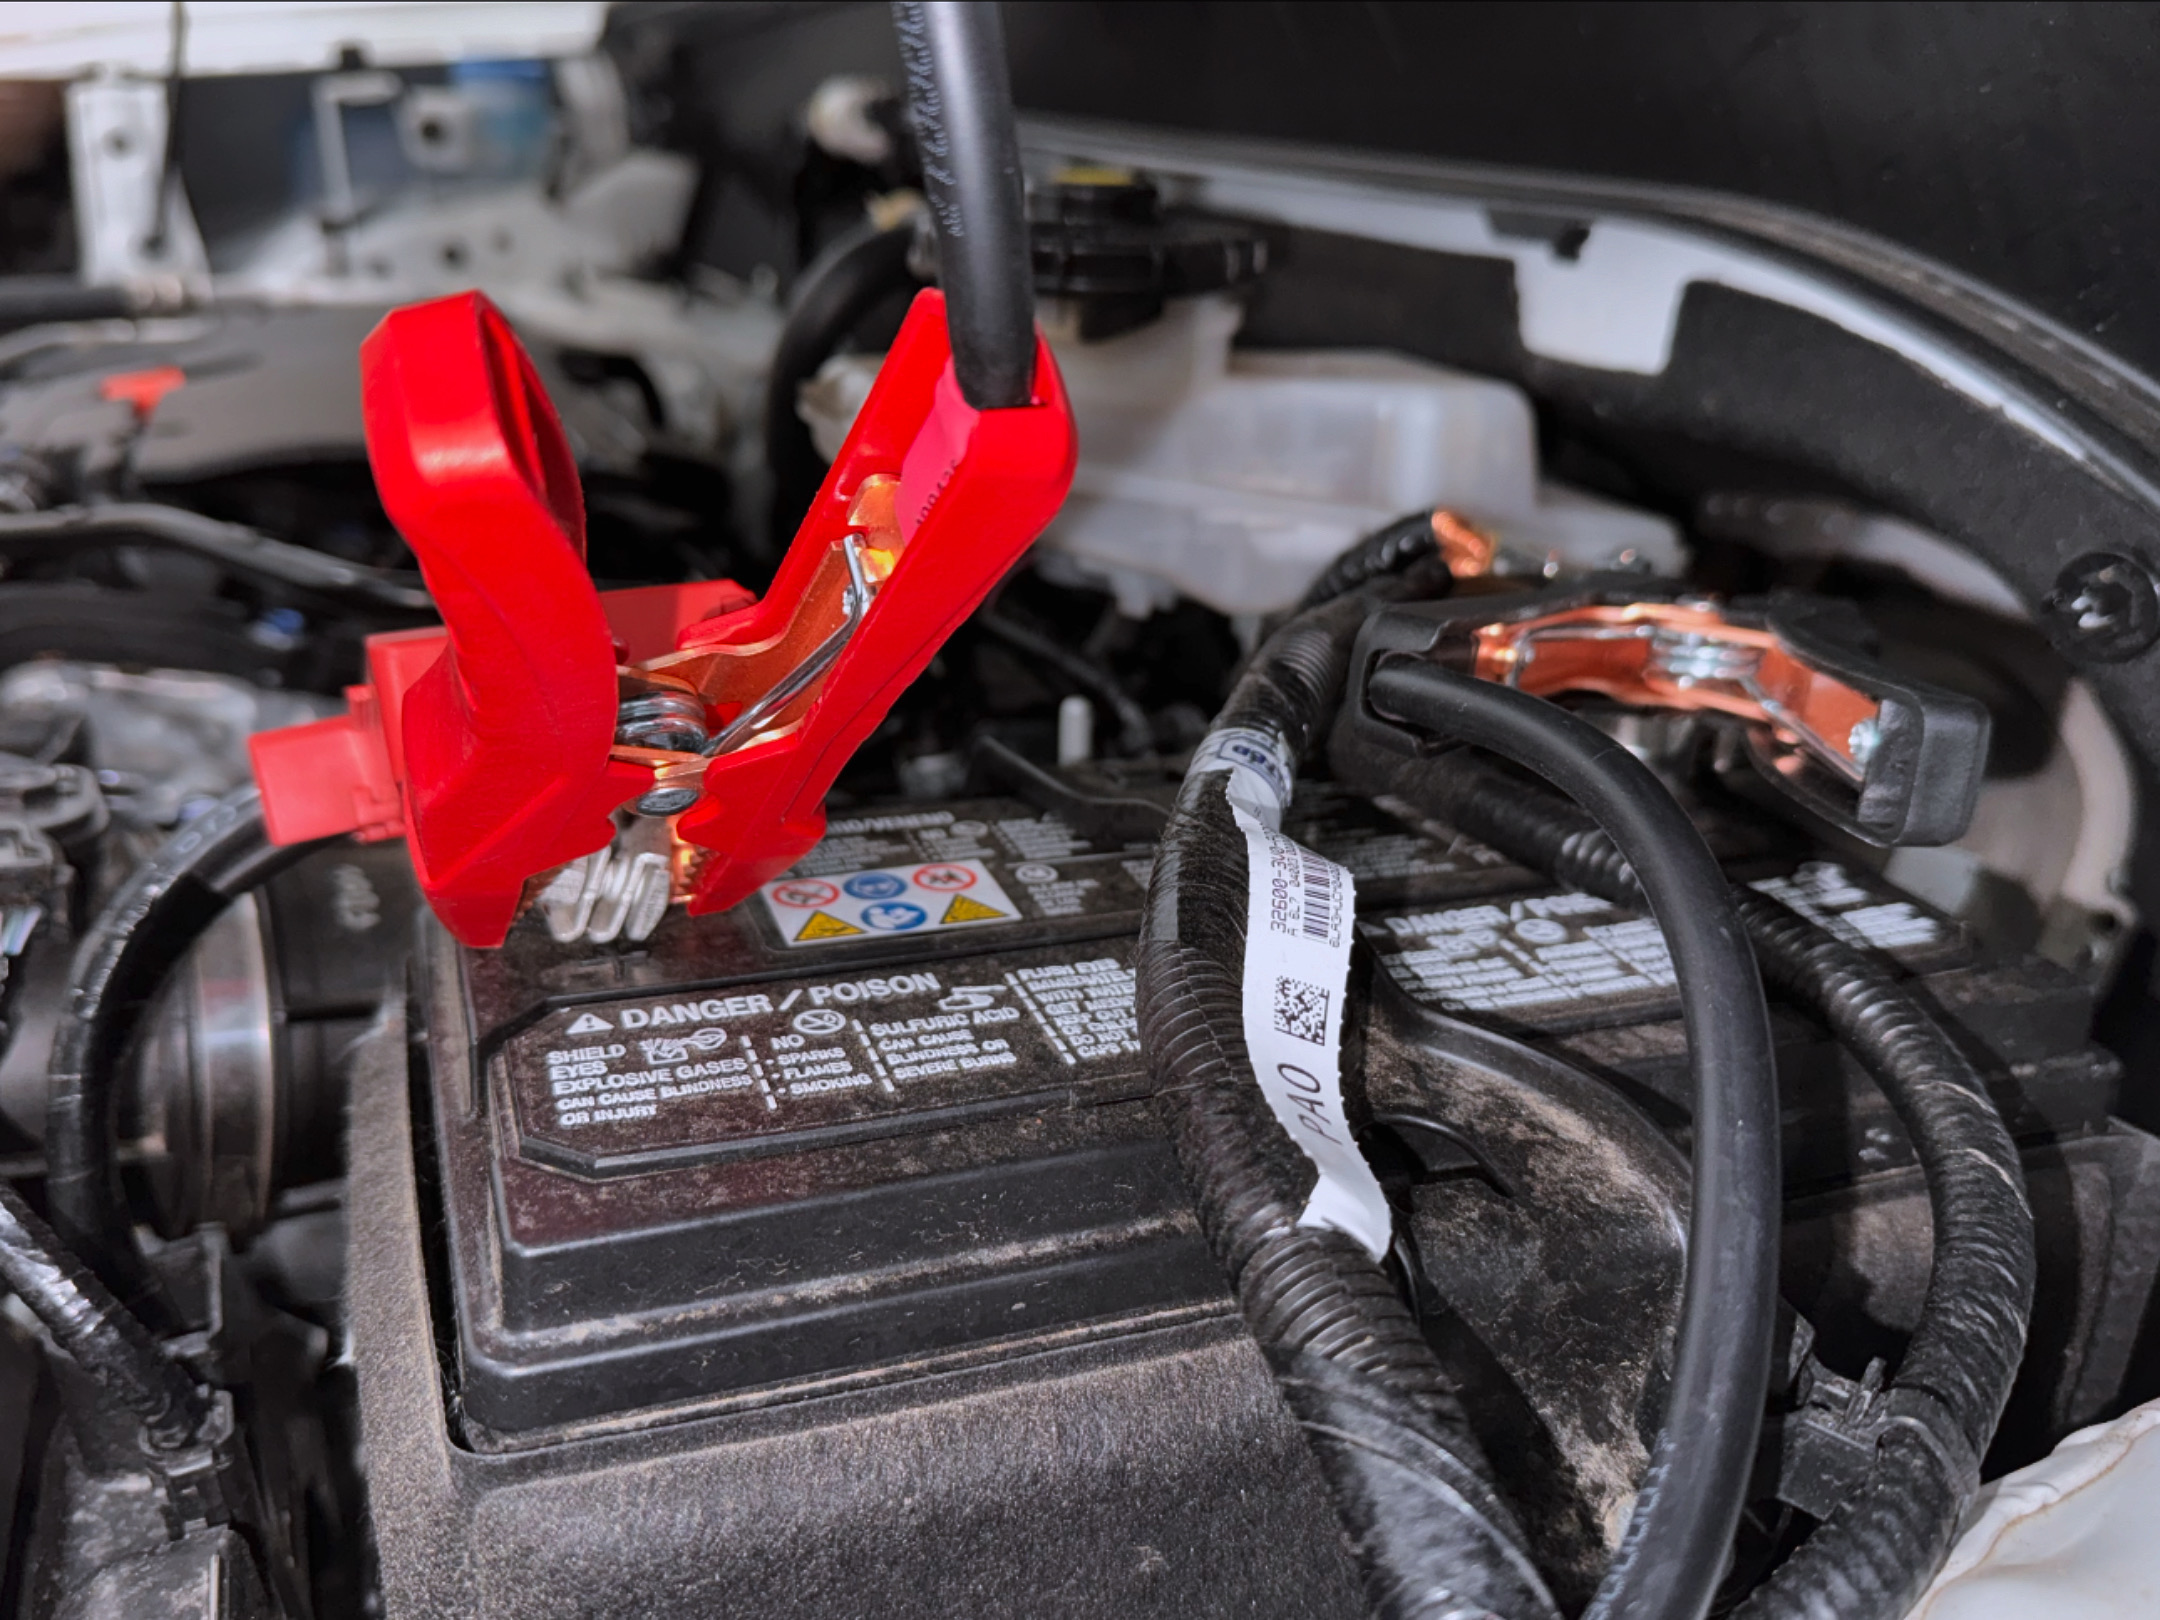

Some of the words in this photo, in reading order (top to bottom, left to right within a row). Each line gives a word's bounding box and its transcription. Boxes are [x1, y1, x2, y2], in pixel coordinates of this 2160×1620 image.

[620, 994, 774, 1030] DANGER
[809, 972, 942, 1006] POISON
[869, 1013, 970, 1038] SULFURIC
[972, 1006, 1020, 1025] ACID
[770, 1033, 805, 1050] NO
[918, 1028, 975, 1047] CAUSE
[1069, 1033, 1095, 1048] DO
[546, 1043, 626, 1066] SHIELD
[777, 1047, 846, 1066] SPARKS
[885, 1042, 980, 1067] BLINDNESS
[982, 1038, 1010, 1052] OR
[550, 1060, 608, 1081] EYES
[553, 1067, 674, 1096] EXPLOSIVE
[676, 1057, 748, 1081] GASES
[783, 1060, 853, 1080] FLAMES
[893, 1058, 959, 1080] SEVERE
[959, 1051, 1017, 1070] BURNS
[556, 1096, 596, 1112] CAN
[598, 1088, 658, 1107] CAUSE
[660, 1074, 753, 1100] BLINDNESS
[789, 1073, 873, 1096] SMOKING
[560, 1110, 591, 1126] OR
[593, 1104, 658, 1122] INJURY
